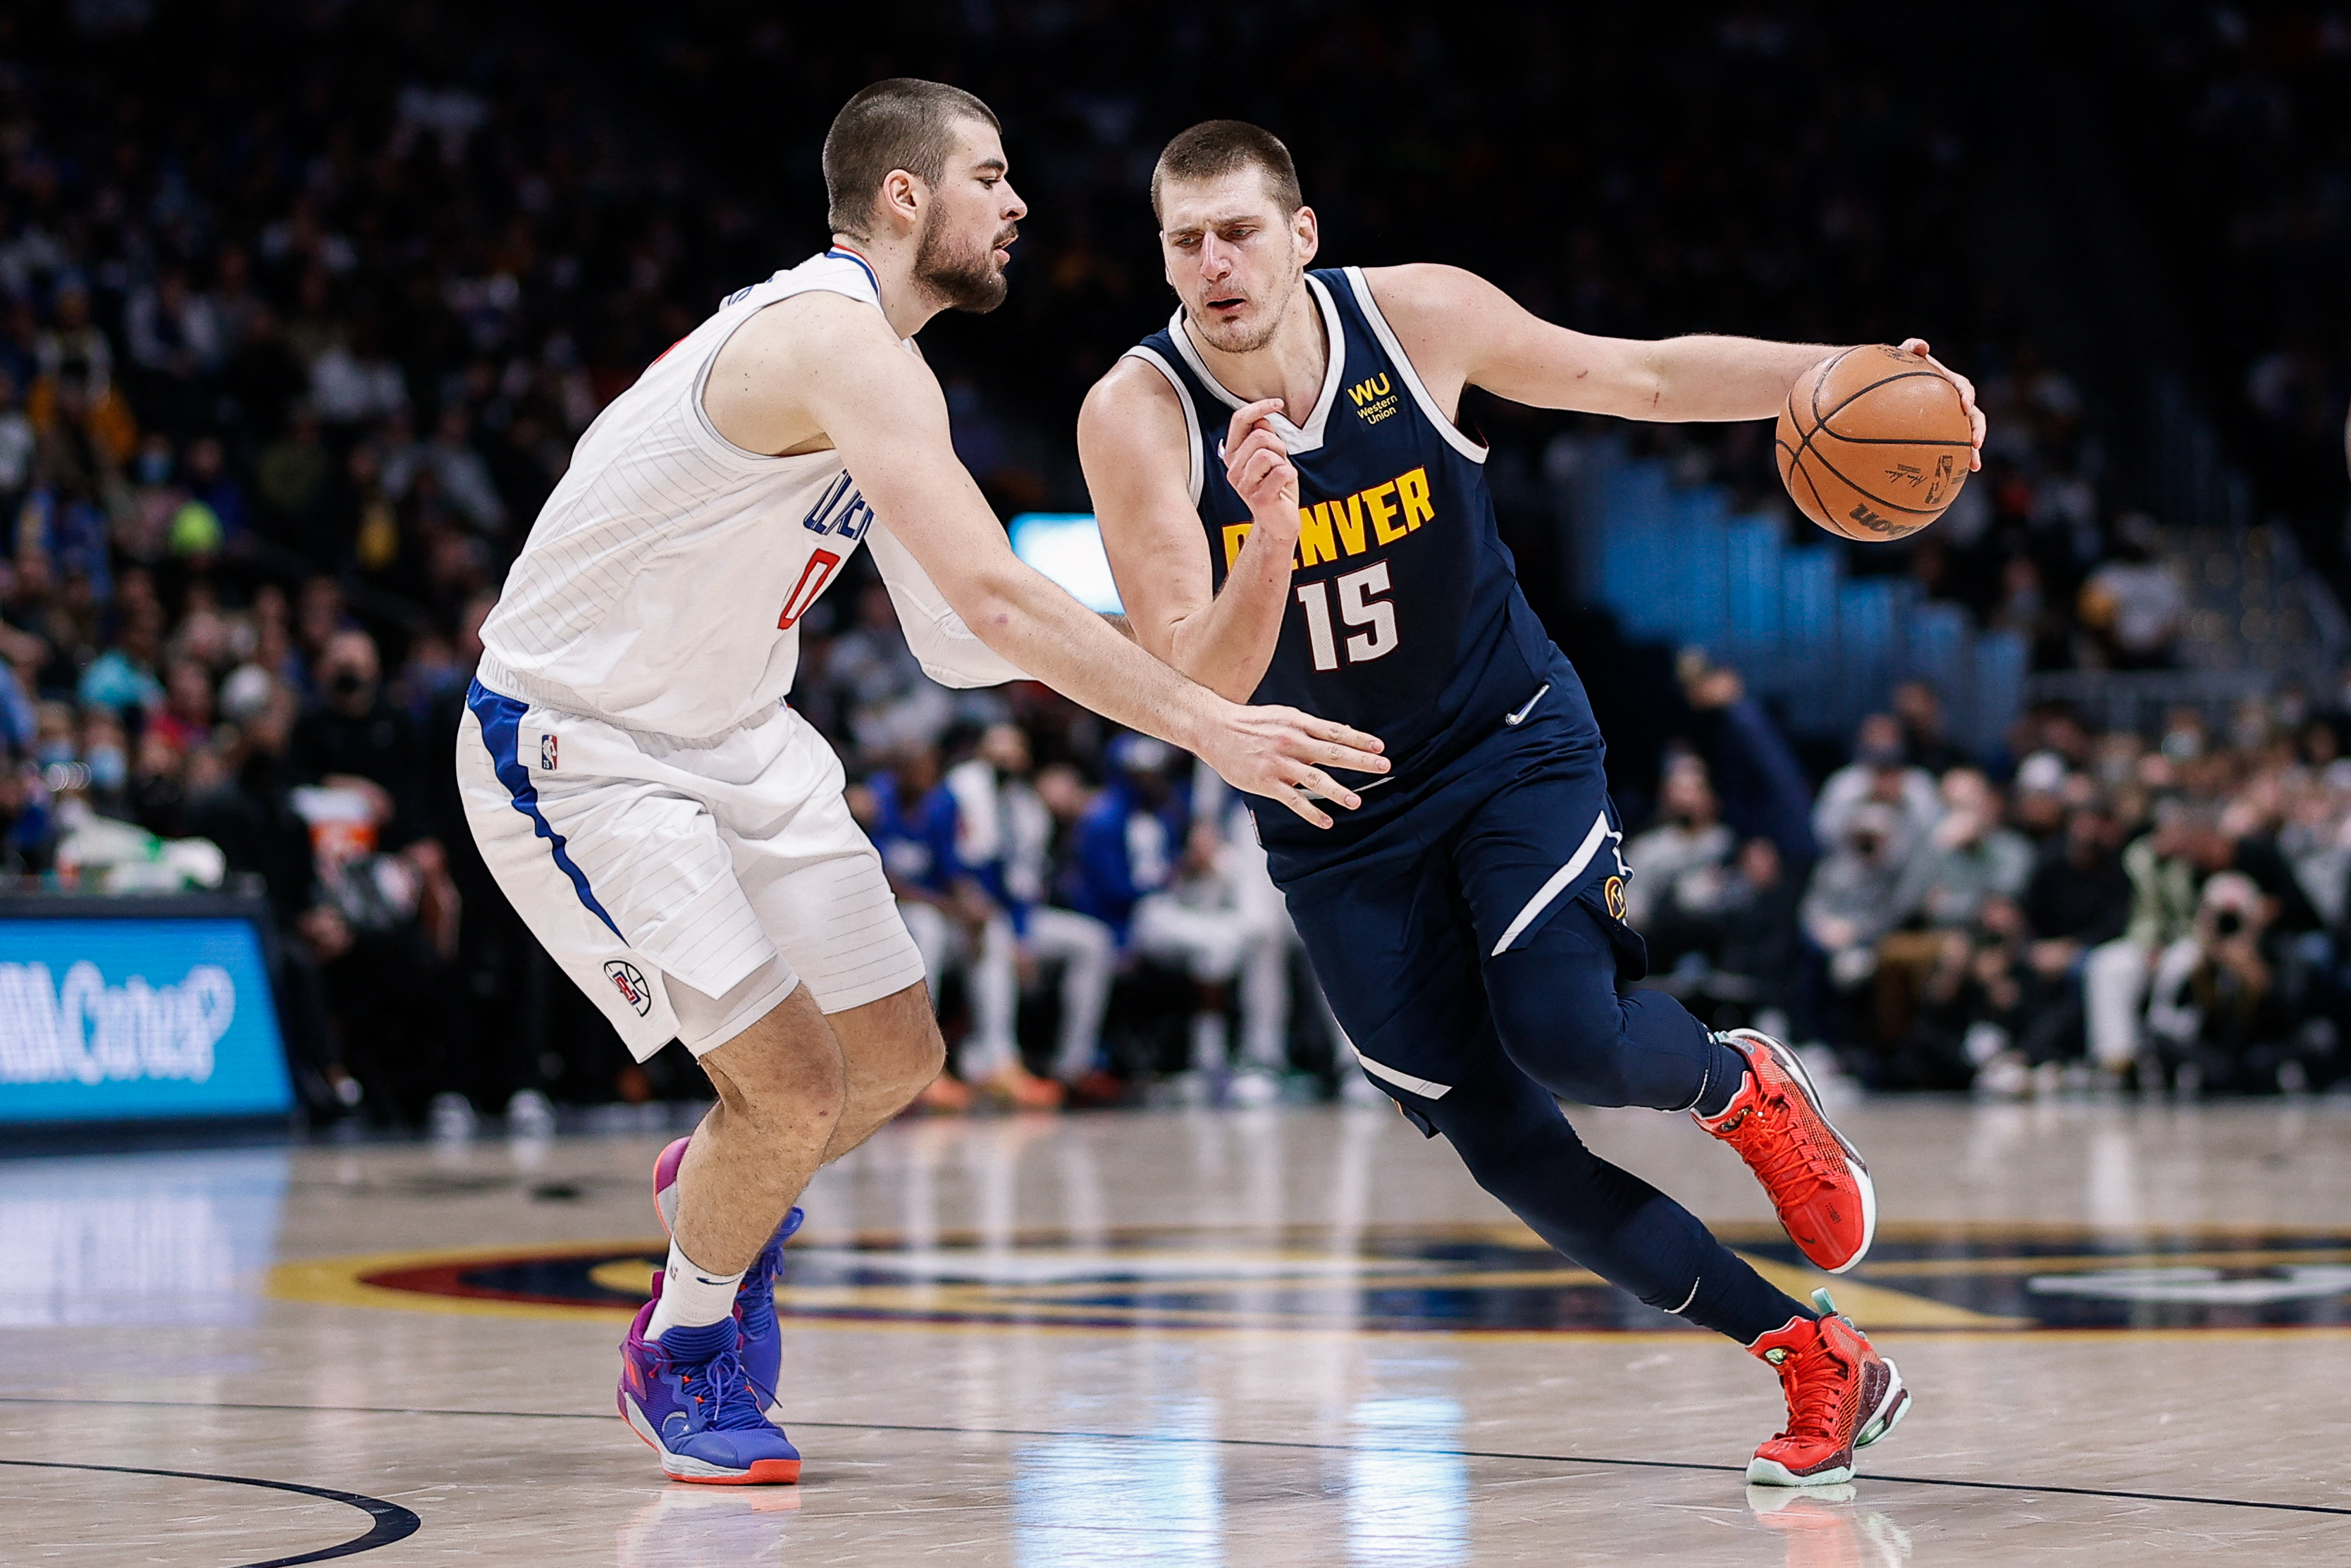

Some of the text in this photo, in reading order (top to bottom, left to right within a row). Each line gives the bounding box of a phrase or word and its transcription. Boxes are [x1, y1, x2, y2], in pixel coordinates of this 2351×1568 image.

[1347, 372, 1390, 407] WU
[1357, 395, 1397, 419] Western
[1367, 406, 1397, 425] Union
[1221, 464, 1436, 575] DNVER
[777, 548, 841, 630] 0
[1295, 559, 1400, 672] 15
